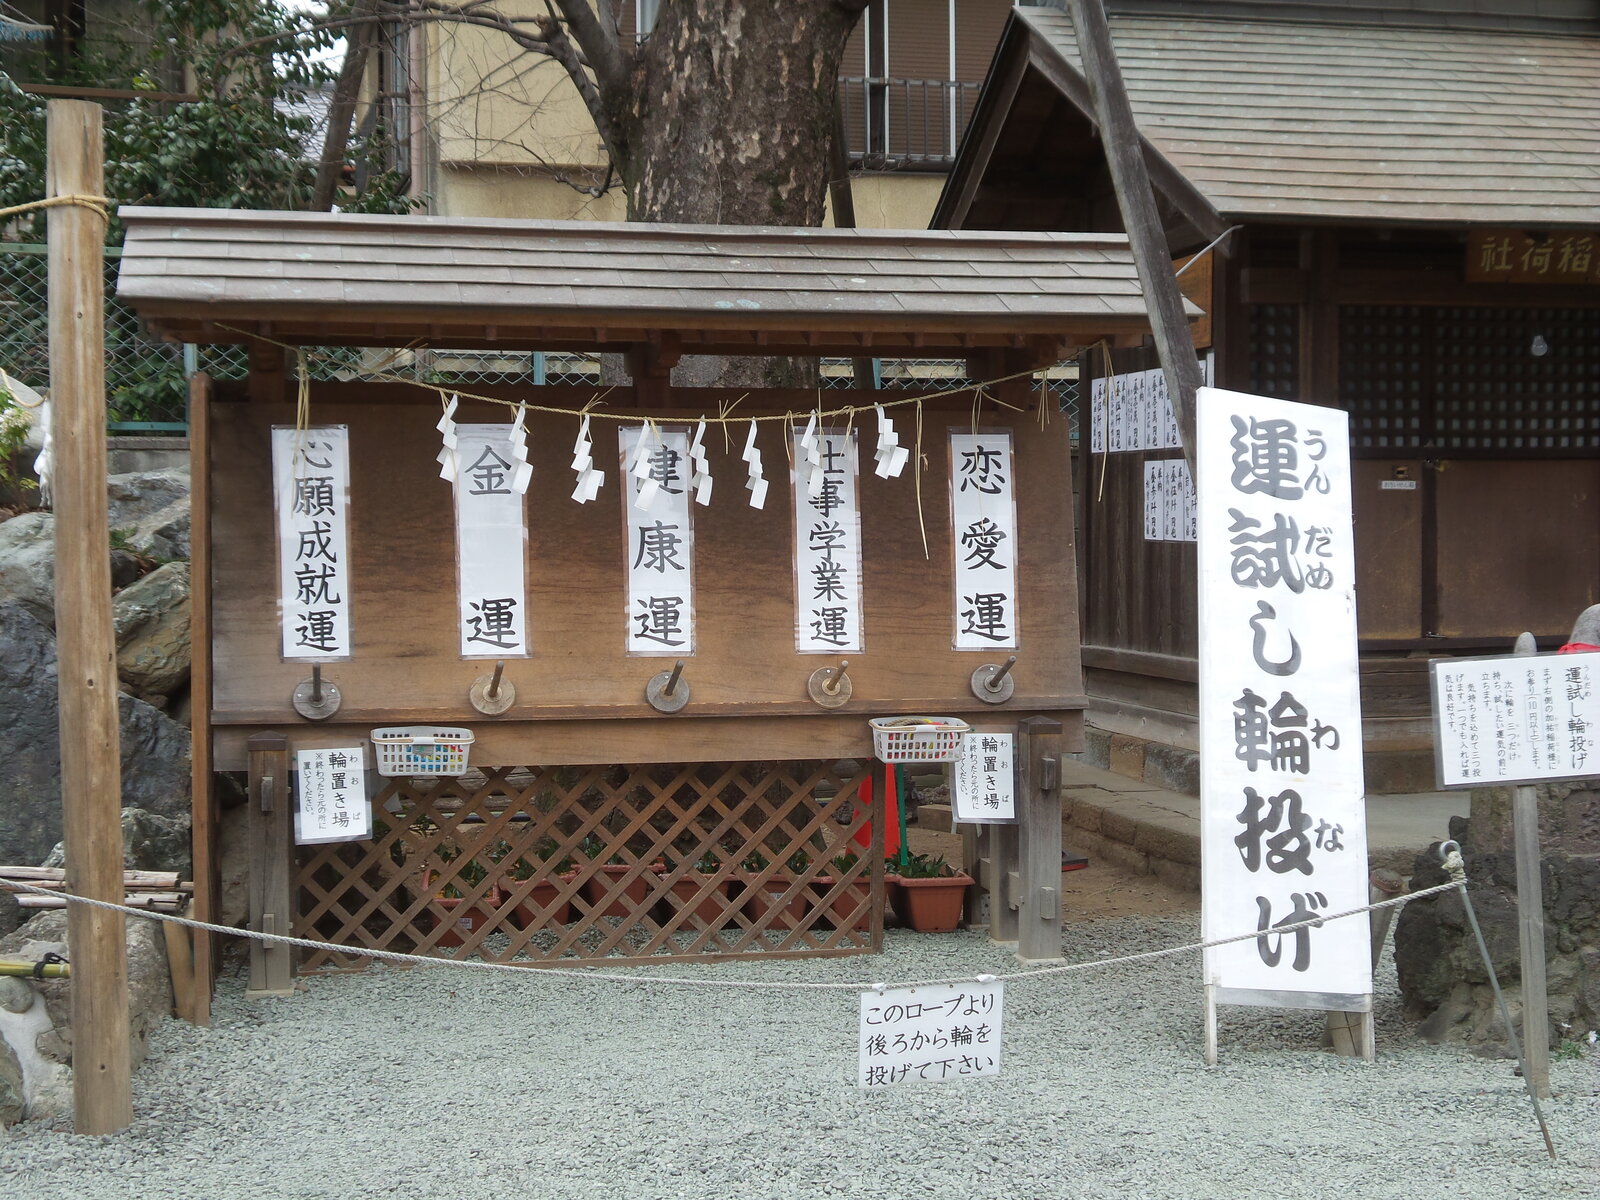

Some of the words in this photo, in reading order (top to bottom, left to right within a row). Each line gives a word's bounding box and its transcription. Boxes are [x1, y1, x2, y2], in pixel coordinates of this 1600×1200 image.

[1480, 236, 1600, 275] 稲荷社
[291, 440, 341, 652] 心願成就運
[630, 443, 687, 647] 健康運
[804, 439, 851, 647] 仕事学業運
[959, 445, 1011, 643] 恋愛運
[1228, 414, 1328, 972] 運試し輪投げ
[1565, 666, 1588, 770] 運試し輪投げ
[1310, 718, 1340, 751] わ
[328, 751, 350, 828] 輪置き場
[981, 736, 999, 810] 輪置き場
[1314, 818, 1344, 852] な
[865, 1023, 992, 1057] 後ろから輪を
[866, 993, 995, 1025] このロープより
[864, 1054, 994, 1087] 投げて下さい
